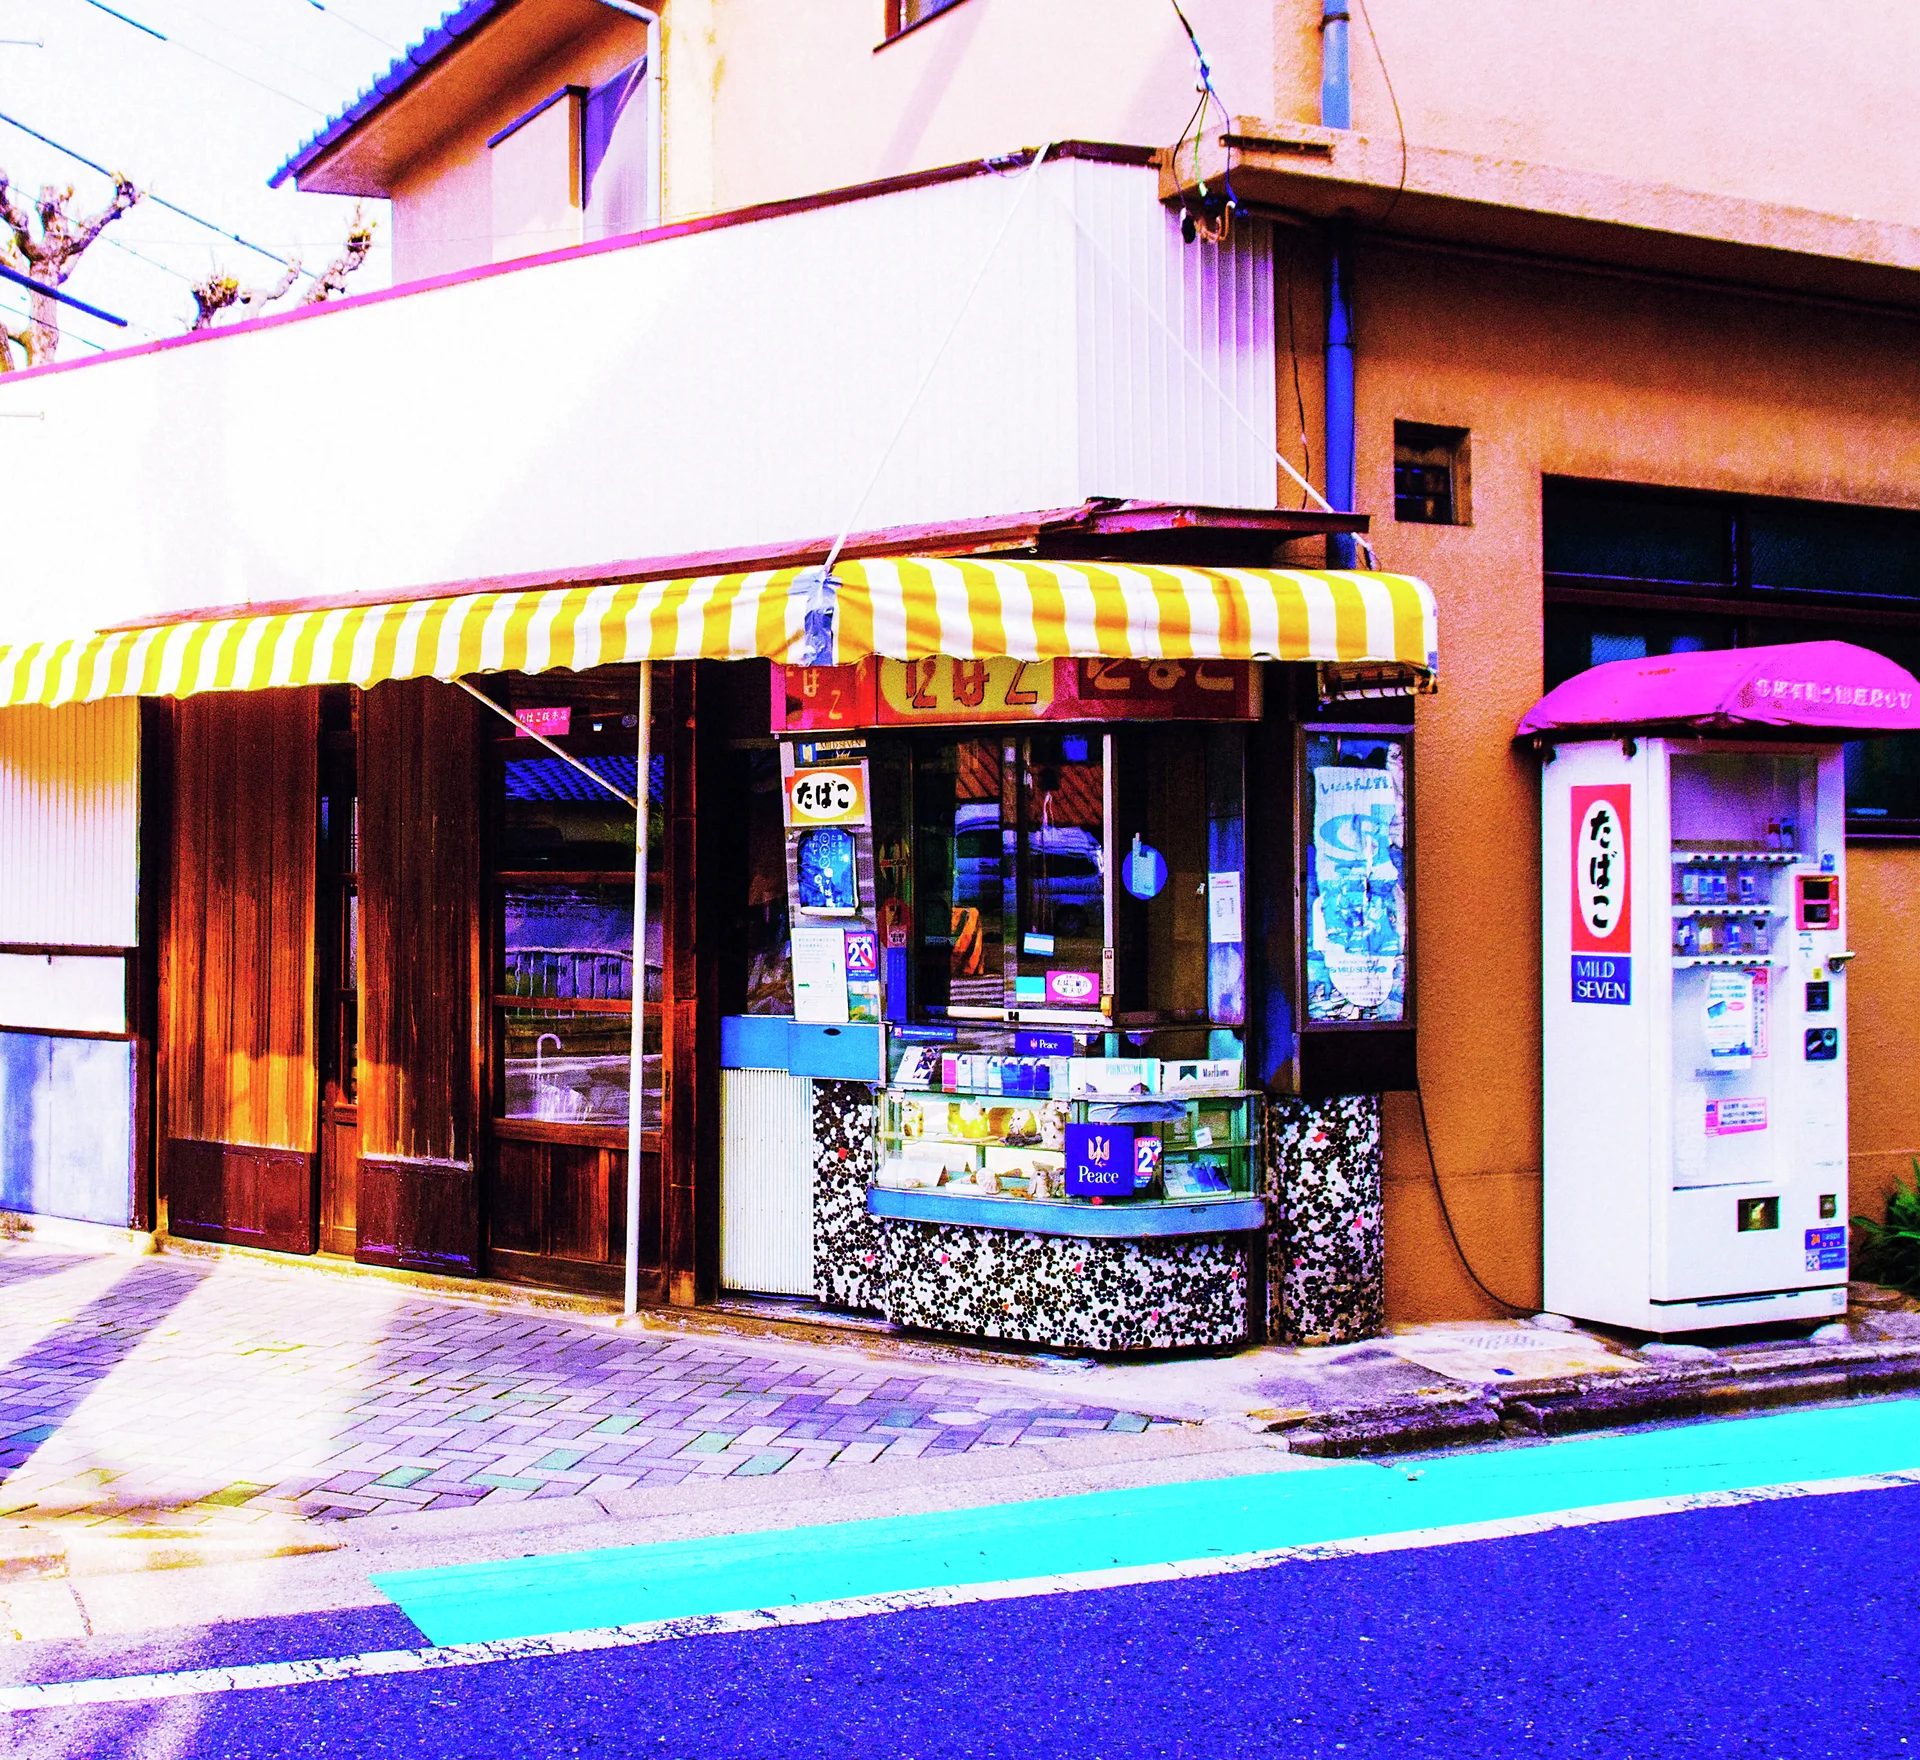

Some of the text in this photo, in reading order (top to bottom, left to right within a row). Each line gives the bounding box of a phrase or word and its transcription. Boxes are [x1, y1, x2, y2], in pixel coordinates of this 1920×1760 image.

[796, 780, 850, 809] たばこ
[1590, 809, 1618, 929] たばこ
[847, 936, 872, 944] UNDER
[848, 943, 874, 967] 20
[1577, 960, 1615, 978] MILD
[1576, 979, 1626, 999] SEVEN
[1039, 1039, 1059, 1050] Peace
[1202, 1064, 1230, 1078] Marlboro
[1078, 1165, 1120, 1184] Peace
